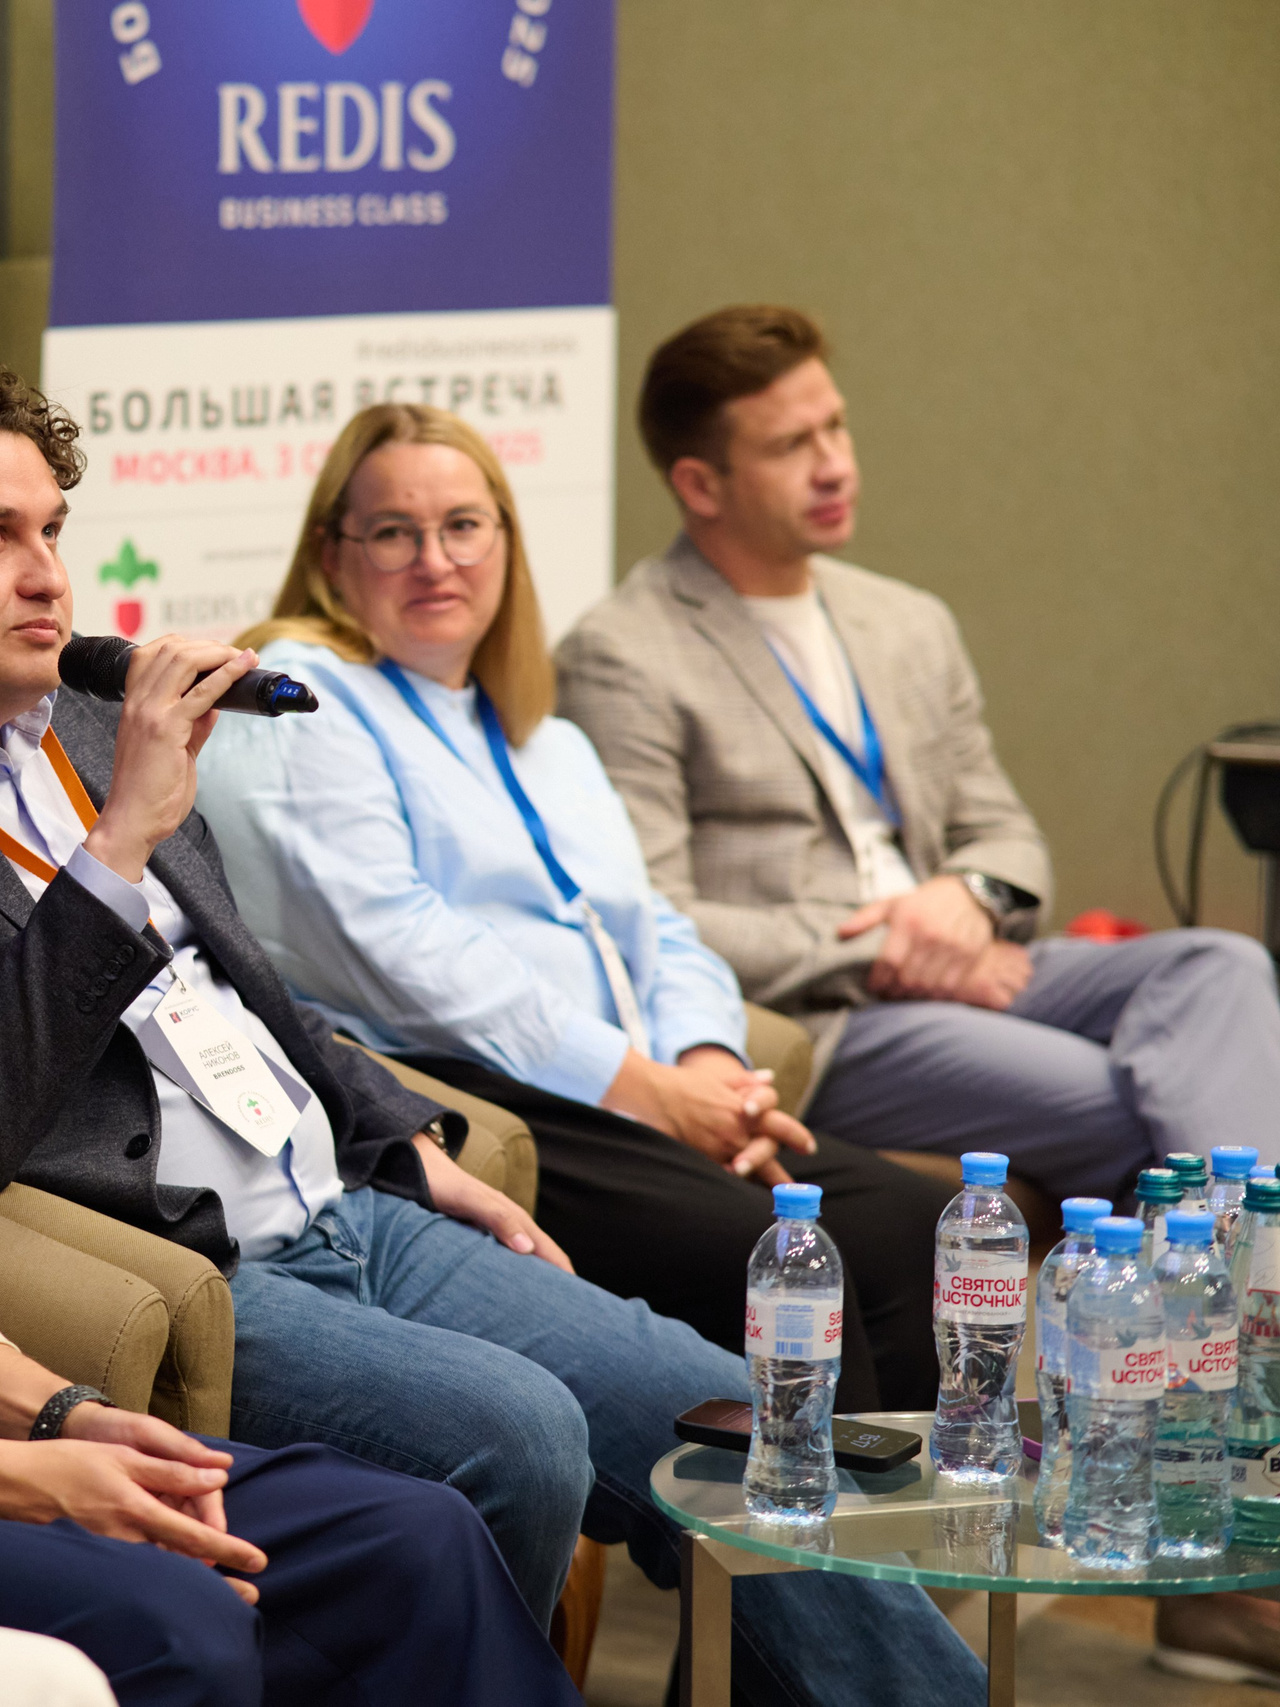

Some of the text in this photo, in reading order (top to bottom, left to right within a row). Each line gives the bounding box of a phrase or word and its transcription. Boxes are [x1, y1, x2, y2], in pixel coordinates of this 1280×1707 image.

[218, 79, 457, 174] REDIS
[219, 191, 448, 229] BUSINESS CLASS
[89, 381, 335, 434] БОЛЬШАЯ
[199, 1041, 233, 1060] АЛЕКСЕЙ
[202, 1051, 240, 1069] НИКОНОВ
[213, 1065, 245, 1080] BRENDOSS
[951, 1275, 1016, 1292] СВЯТОЙ
[942, 1289, 1022, 1308] ИСТОЧНИК
